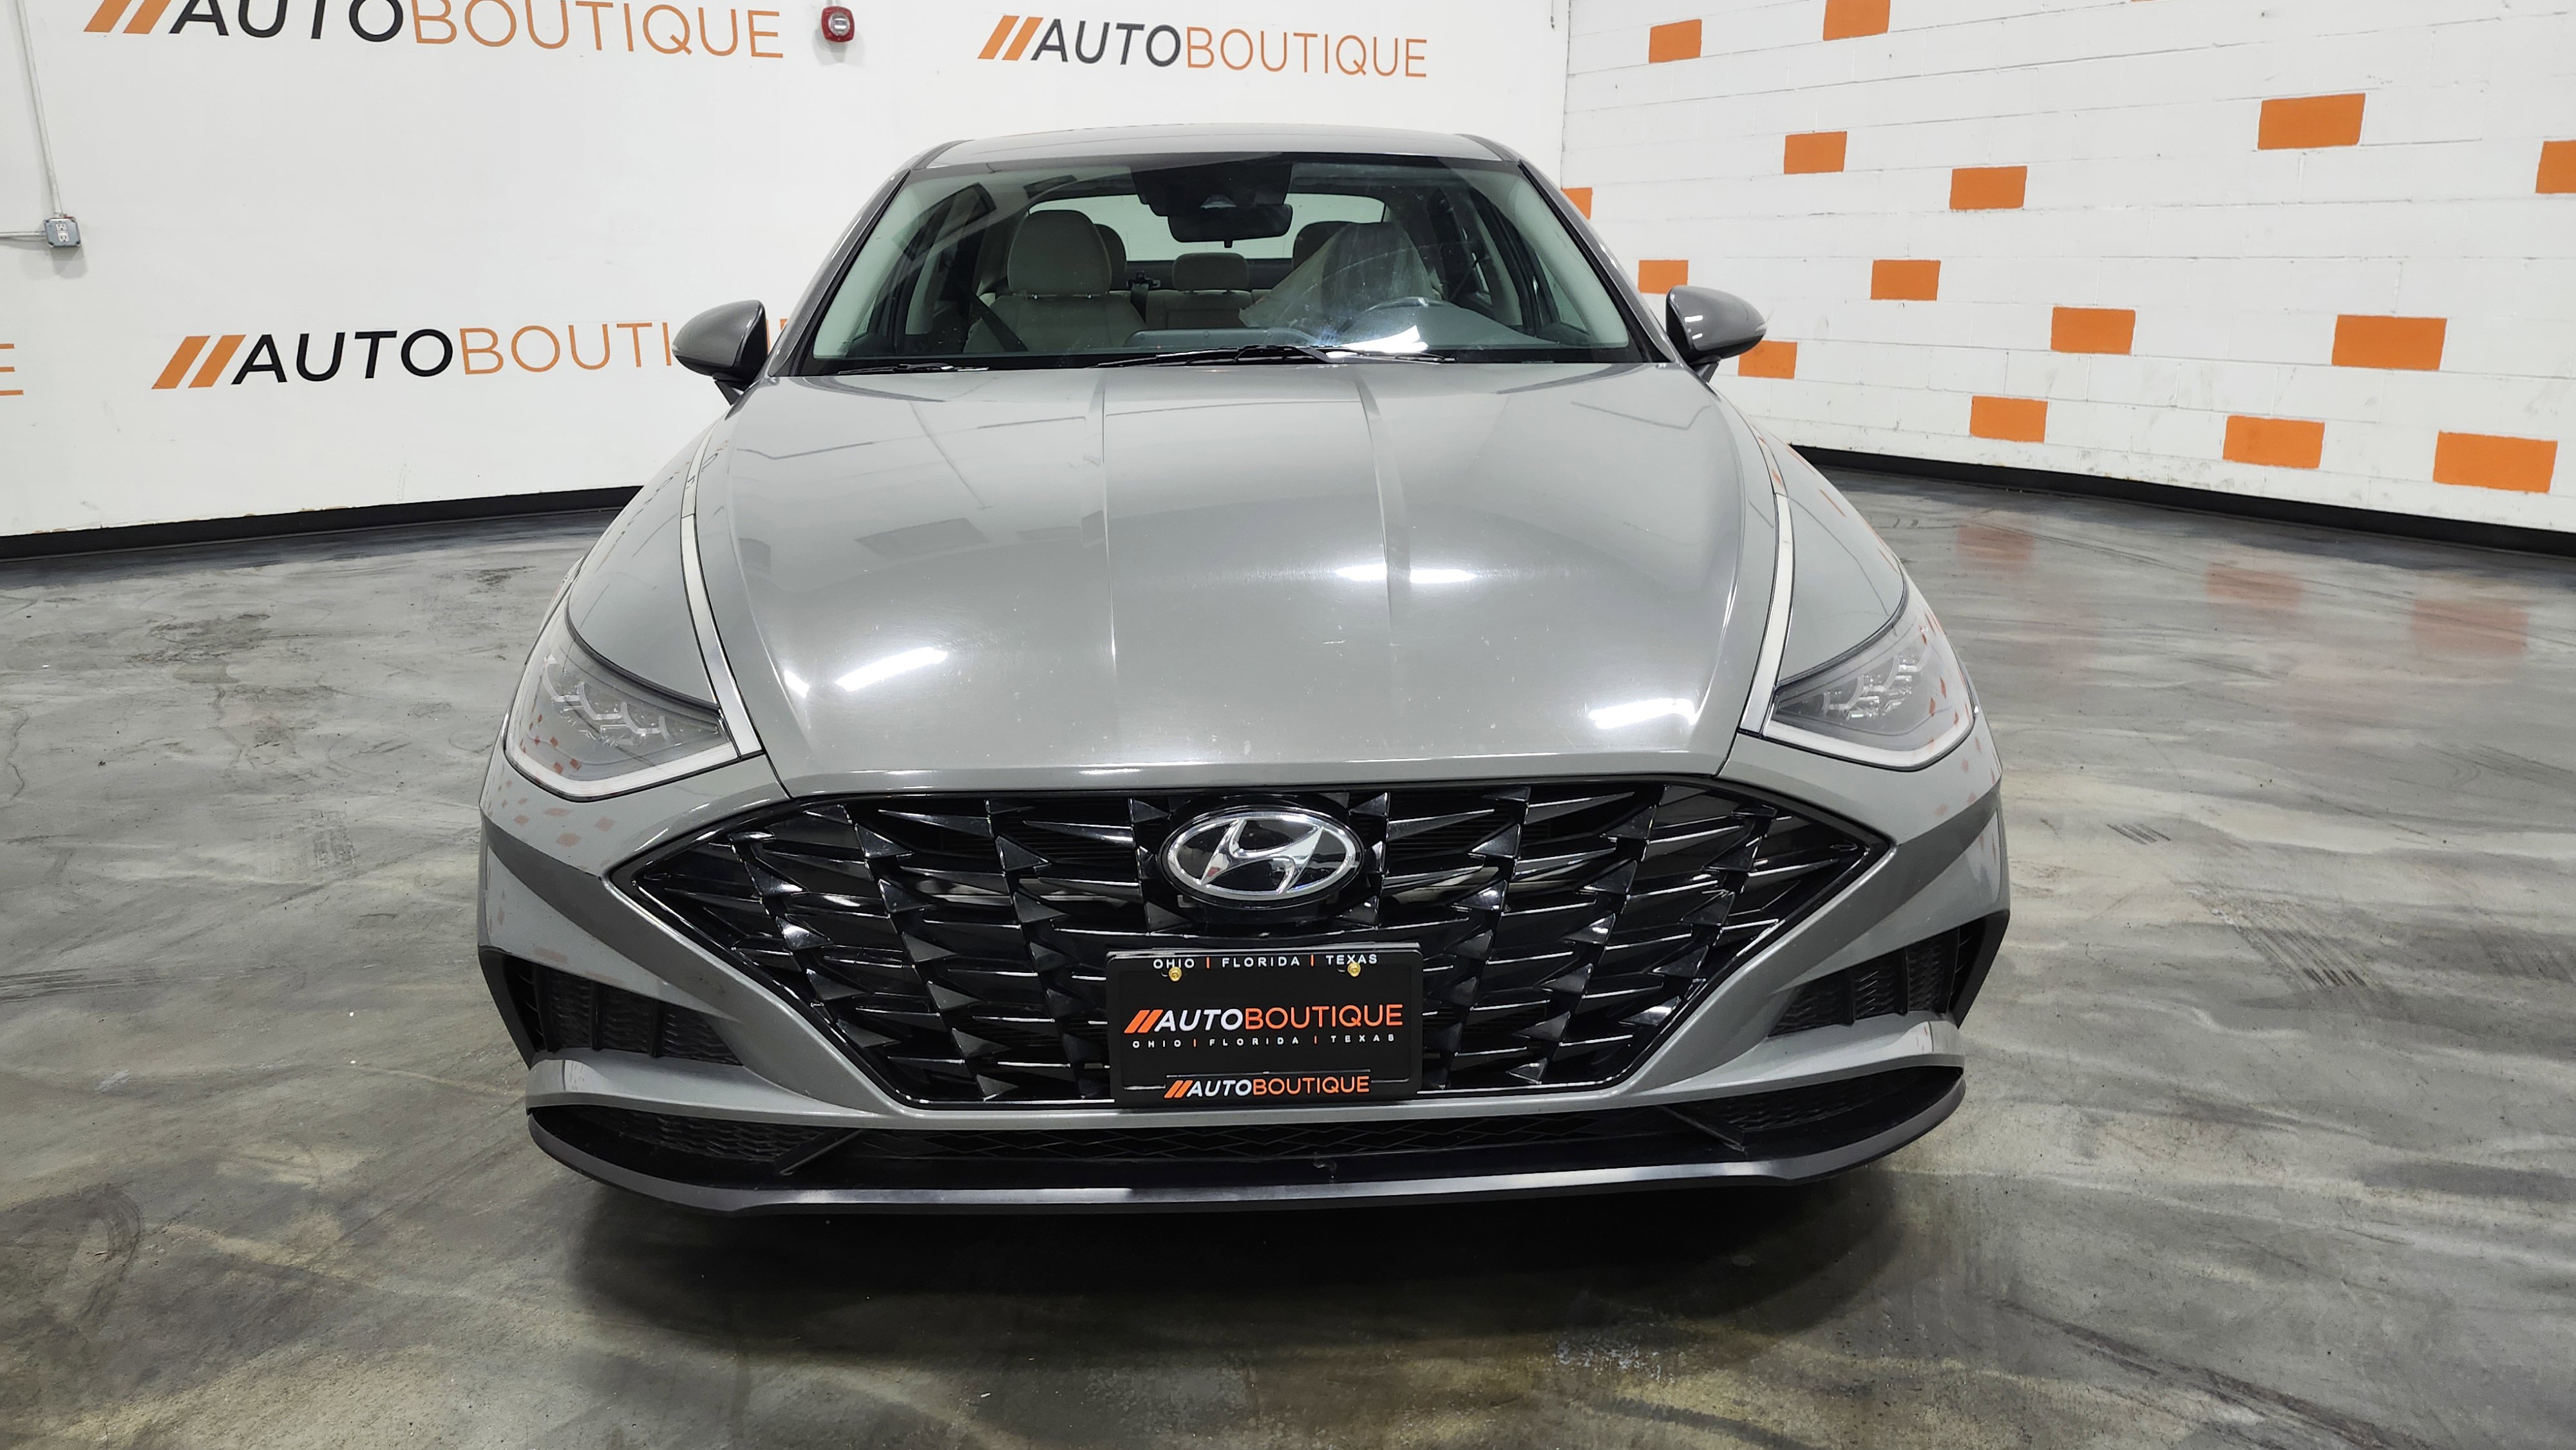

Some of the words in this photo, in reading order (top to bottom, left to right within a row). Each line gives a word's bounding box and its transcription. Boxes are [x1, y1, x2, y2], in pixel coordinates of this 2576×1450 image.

[1030, 19, 1427, 77] AUTOBOUTIQUE
[231, 319, 788, 386] AUTOBOUTI
[1153, 958, 1195, 969] OHIO
[1222, 956, 1300, 968] FLORIDA
[1325, 954, 1378, 965] TEXAS
[1154, 1004, 1403, 1032] AUTOBOUTIQUE
[1132, 1040, 1181, 1049] OHIO
[1209, 1037, 1299, 1046] FLORIDA
[1331, 1033, 1394, 1043] TEXAS
[1186, 1076, 1370, 1097] AUTOBOUTIQUE
